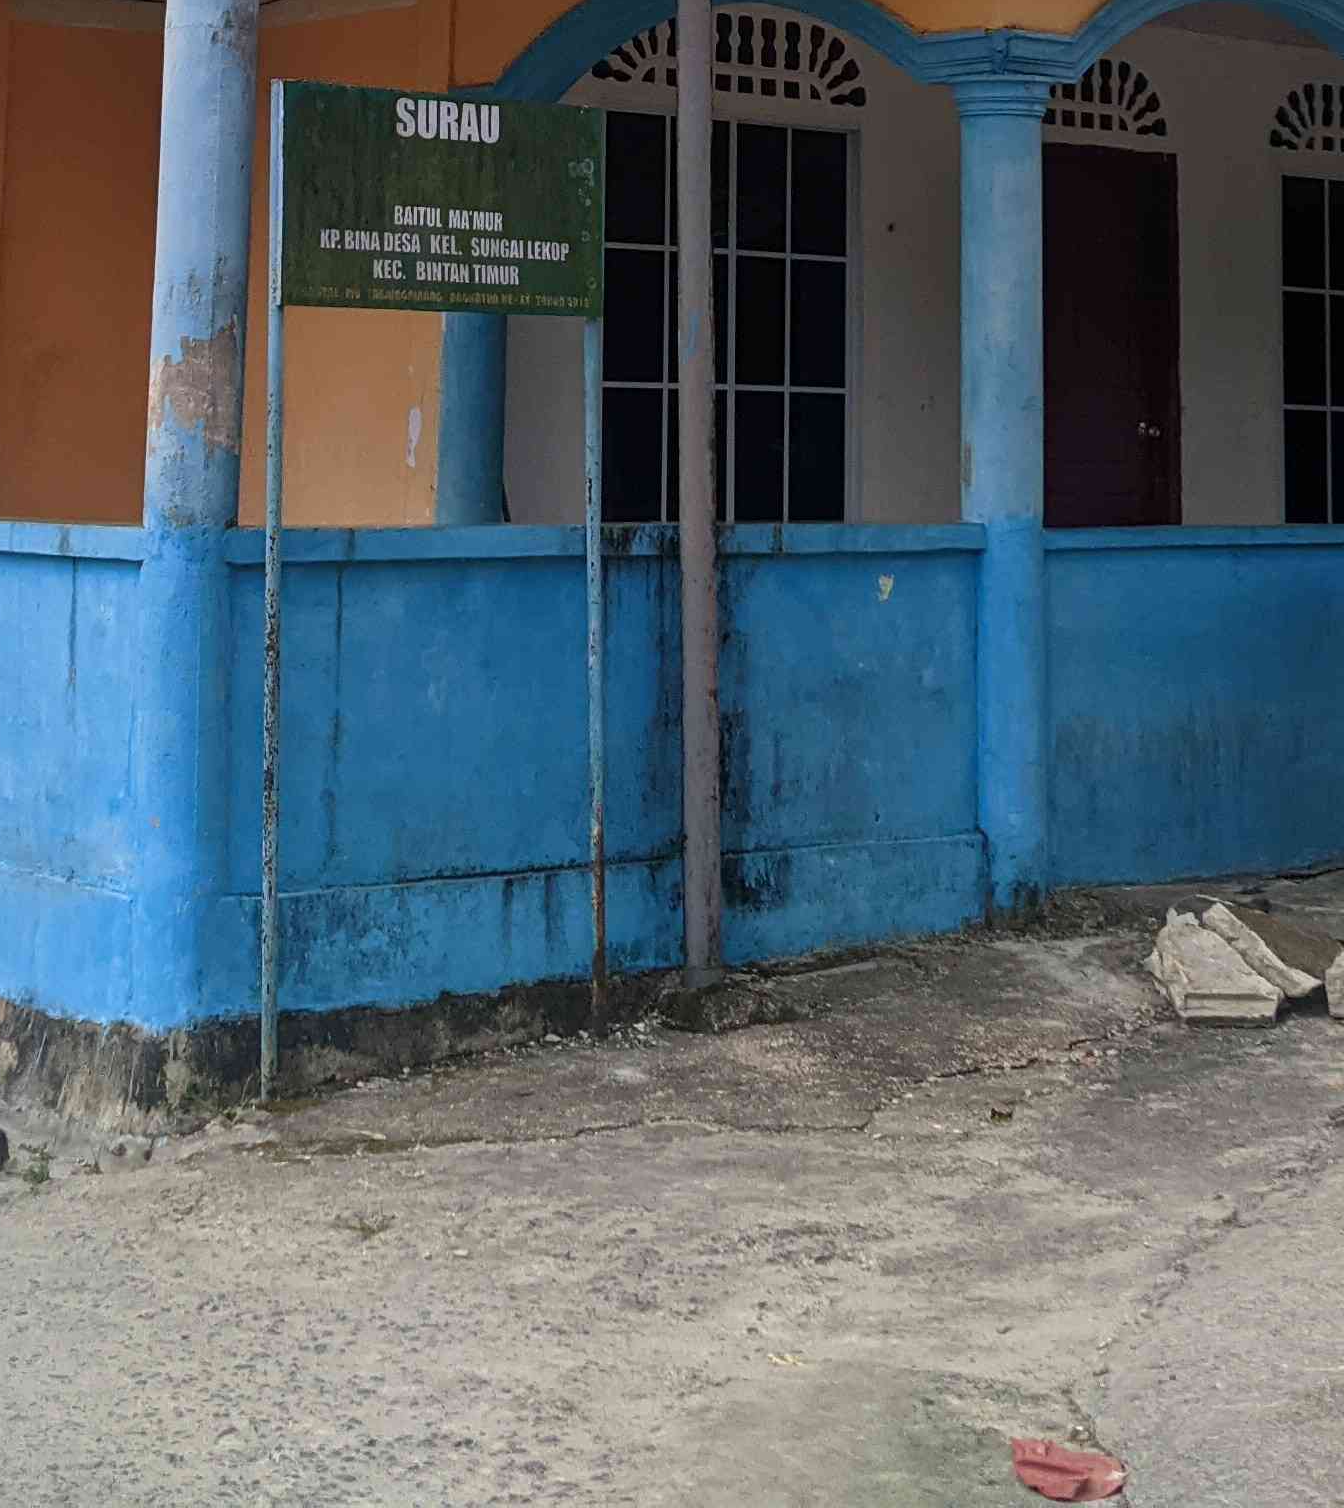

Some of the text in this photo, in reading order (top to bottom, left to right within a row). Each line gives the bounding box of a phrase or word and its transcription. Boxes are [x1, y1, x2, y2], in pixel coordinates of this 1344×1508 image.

[395, 97, 501, 144] SURAU
[394, 205, 504, 232] BAITUL MA'MUR
[320, 229, 570, 261] KP. BINA DESA KEL. SUNGAI LEKOP
[373, 259, 520, 286] KEC. BINTAN TIMUR
